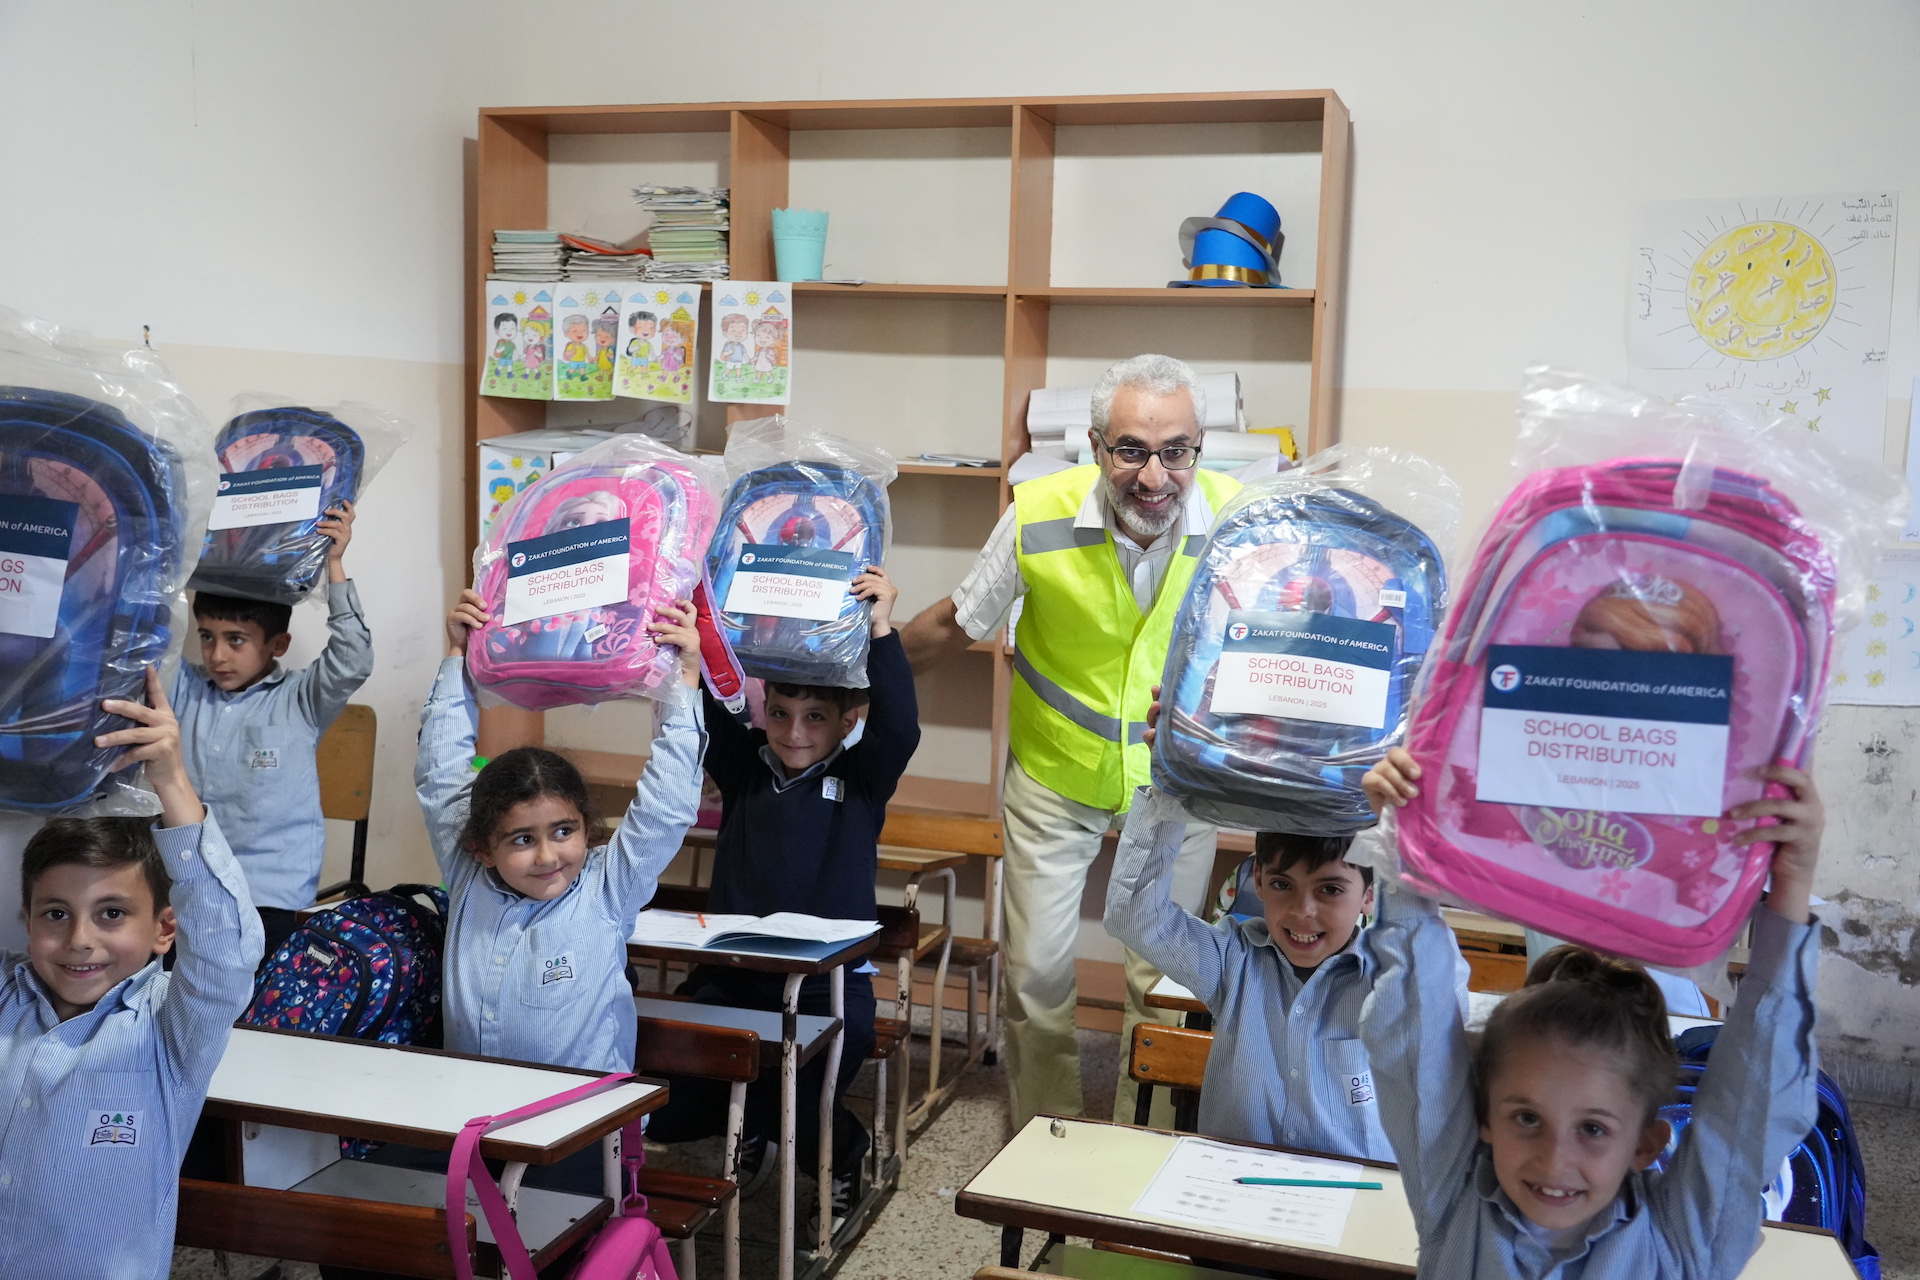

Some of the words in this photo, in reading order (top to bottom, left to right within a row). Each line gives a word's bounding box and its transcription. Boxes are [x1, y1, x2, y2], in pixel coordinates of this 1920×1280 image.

[231, 494, 270, 504] SCHOOL
[273, 491, 299, 500] BAGS
[231, 498, 298, 511] DISTRIBUTION
[11, 522, 23, 530] of
[23, 523, 68, 538] AMERICA
[528, 551, 549, 561] ZAKAT
[548, 542, 589, 556] FOUNDATION
[597, 535, 628, 545] AMERICA
[1, 559, 25, 574] GS
[775, 558, 813, 567] FOUNDATION
[820, 563, 848, 571] AMERICA
[527, 568, 572, 586] SCHOOL
[575, 562, 604, 576] BAGS
[752, 575, 792, 586] SCHOOL
[795, 578, 823, 589] BAGS
[528, 574, 604, 597] DISTRIBUTION
[752, 585, 821, 599] DISTRIBUTION
[543, 596, 570, 605] LEBANON
[1251, 629, 1280, 637] ZAKAT
[1280, 630, 1337, 644] FOUNDATION
[1338, 638, 1350, 646] of
[1349, 640, 1389, 653] AMERICA
[1248, 657, 1309, 673] SCHOOL
[1313, 663, 1355, 680] BAGS
[1249, 671, 1353, 696] DISTRIBUTION
[1524, 675, 1565, 687] ZAKAT
[1565, 677, 1650, 694] FOUNDATION
[1652, 683, 1668, 695] of
[1667, 686, 1727, 699] AMERICA
[1268, 694, 1305, 705] LEBANON
[1310, 700, 1328, 709] 2025
[1523, 718, 1611, 741] SCHOOL
[1618, 726, 1677, 746] BAGS
[1527, 740, 1676, 768] DISTRIBUTION
[1557, 774, 1608, 787] LEBANON
[1615, 778, 1640, 790] 2025
[1580, 837, 1636, 871] First
[545, 960, 553, 969] O
[561, 956, 567, 965] S
[1351, 1077, 1360, 1087] O
[100, 1114, 110, 1125] O
[126, 1115, 134, 1126] S
